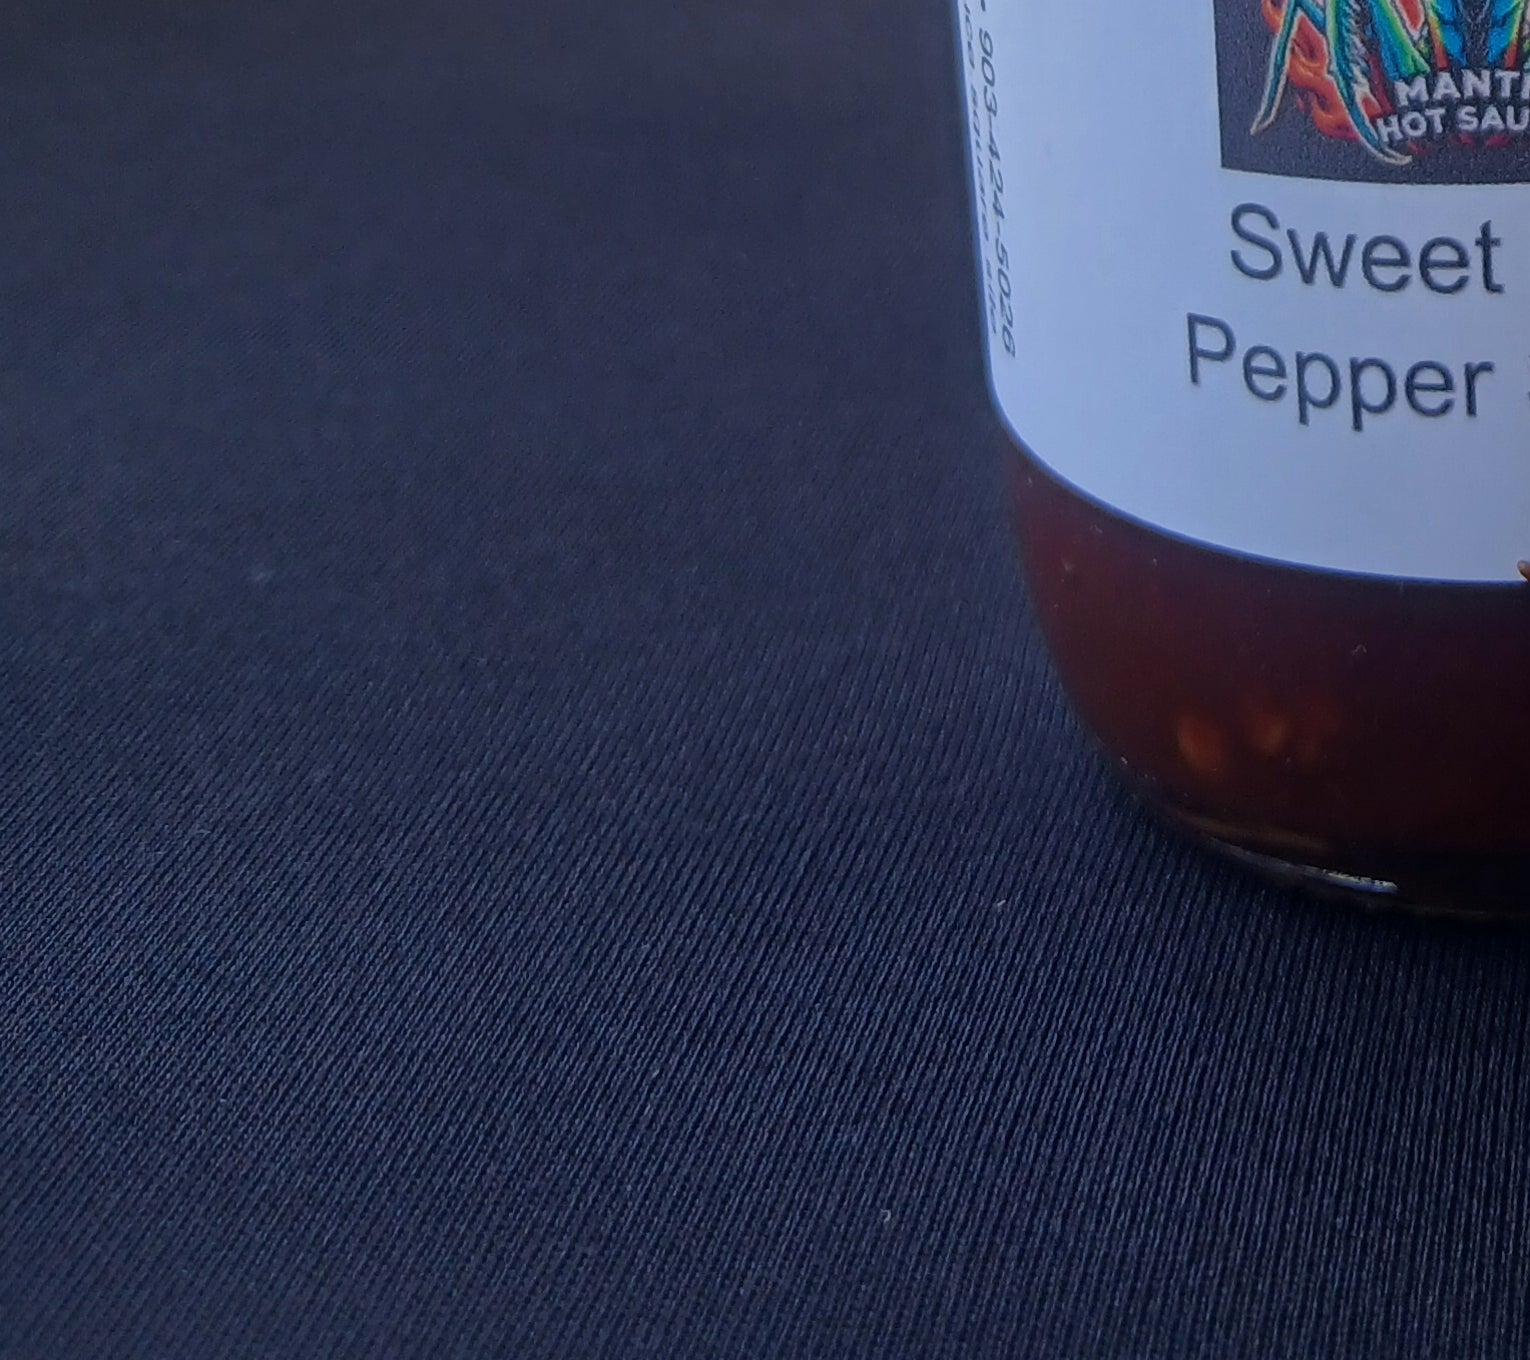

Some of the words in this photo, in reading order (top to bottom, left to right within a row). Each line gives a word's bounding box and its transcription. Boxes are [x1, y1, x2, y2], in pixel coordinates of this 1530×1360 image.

[1375, 107, 1446, 143] HOT
[978, 27, 1016, 359] 903-424-5026
[1229, 201, 1505, 295] Sweet
[1186, 311, 1496, 432] Pepper
